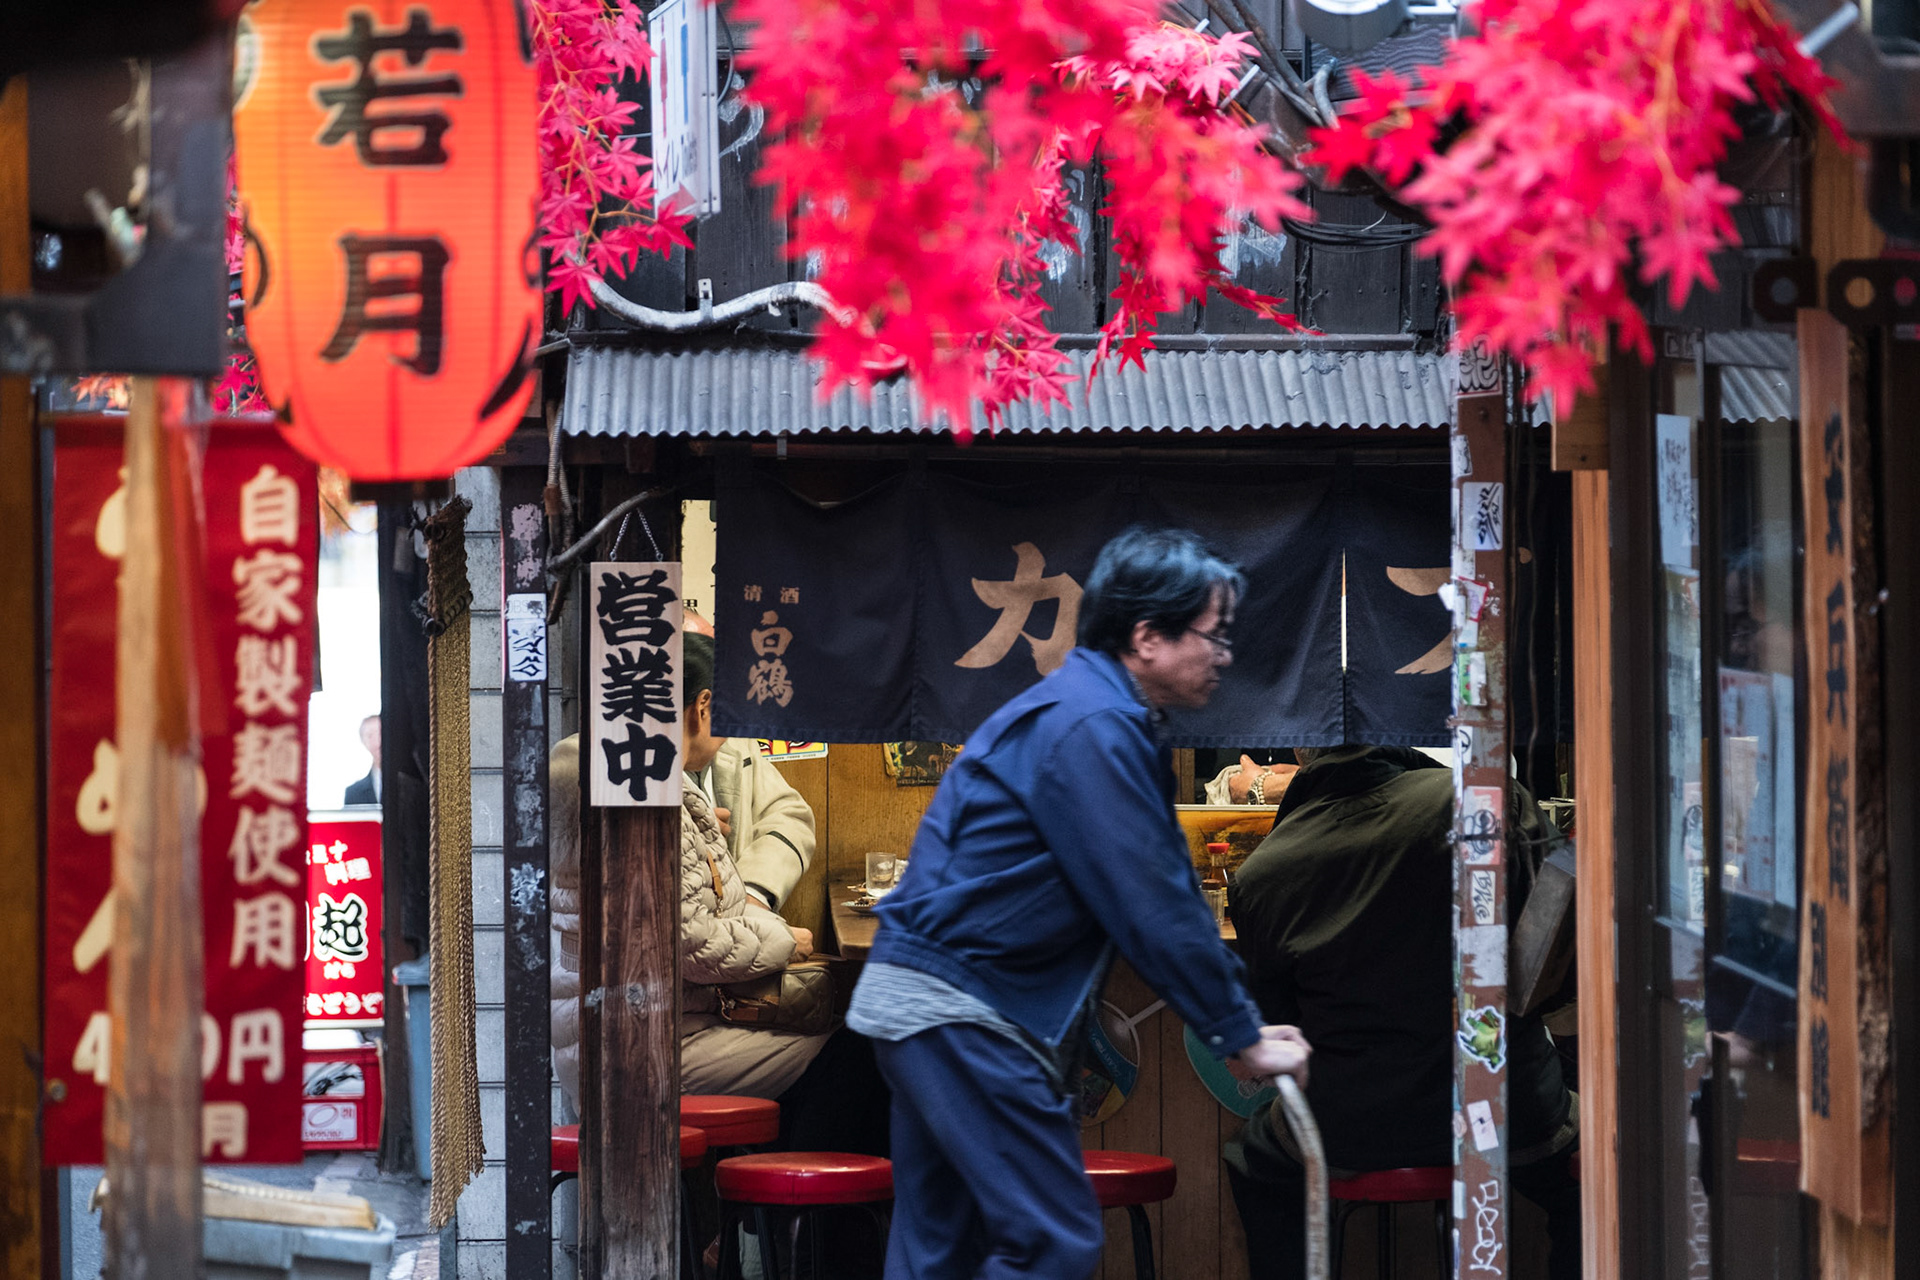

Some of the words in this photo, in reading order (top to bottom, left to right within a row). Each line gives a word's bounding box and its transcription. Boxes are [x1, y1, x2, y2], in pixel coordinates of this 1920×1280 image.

[312, 8, 463, 375] 若月
[744, 584, 800, 604] 清酒
[596, 569, 678, 801] 営業中
[746, 610, 794, 708] 白鶴
[229, 464, 303, 970] 自家製麺使用
[72, 1008, 285, 1084] 4円
[202, 1100, 247, 1159] 月
